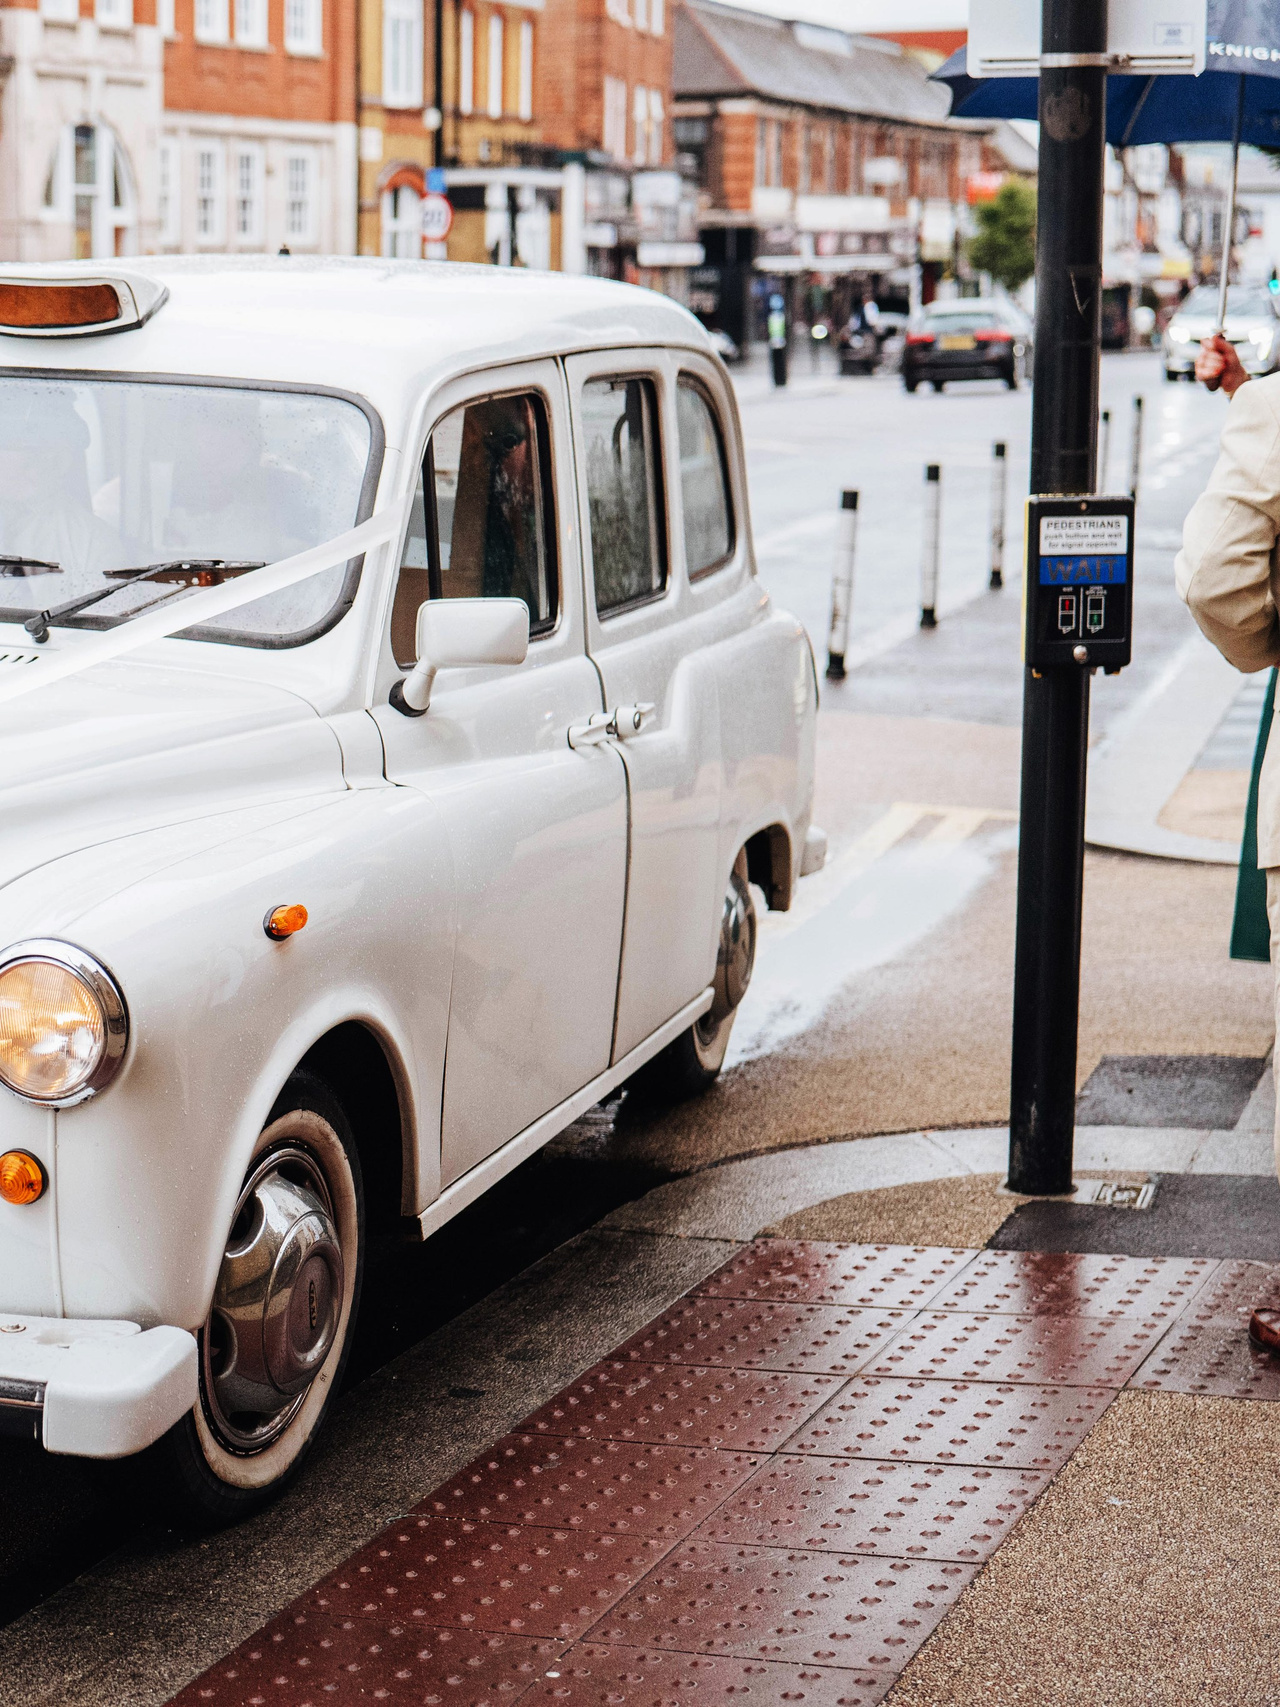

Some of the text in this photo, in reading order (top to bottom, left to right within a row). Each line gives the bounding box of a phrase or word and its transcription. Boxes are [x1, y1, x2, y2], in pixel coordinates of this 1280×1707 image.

[1046, 520, 1121, 530] PEDESTRIANS
[1044, 532, 1063, 540] push
[1061, 541, 1084, 549] signal
[1085, 541, 1118, 549] opposite
[1047, 559, 1118, 581] WAIT
